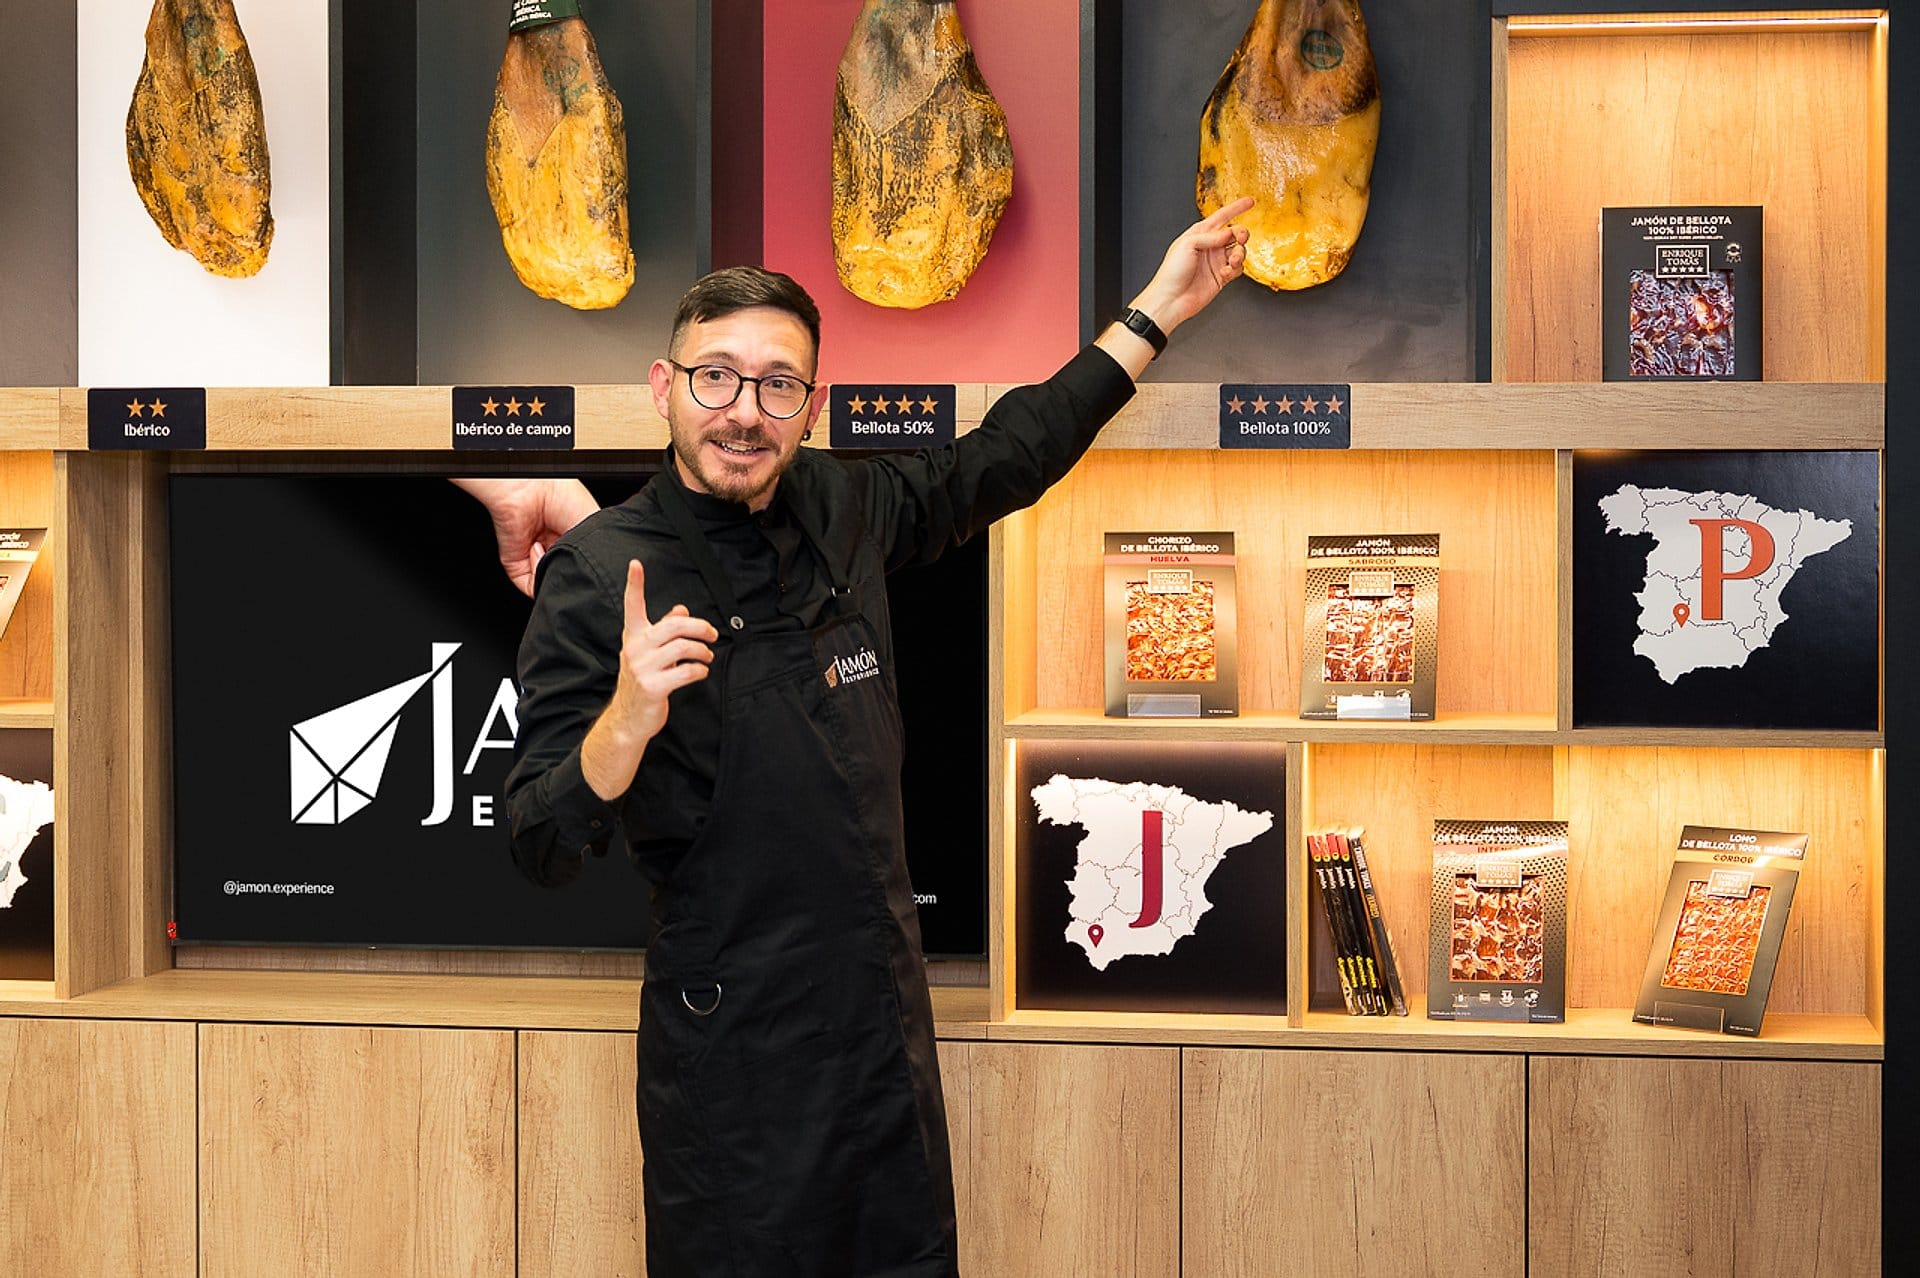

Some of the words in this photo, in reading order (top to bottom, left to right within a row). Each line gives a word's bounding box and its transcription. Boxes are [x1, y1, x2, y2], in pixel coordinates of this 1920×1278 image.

[1631, 214, 1667, 226] JAMÓN
[1669, 216, 1683, 225] DE
[1686, 216, 1732, 225] BELLOTA
[1648, 226, 1674, 235] 100%
[1676, 224, 1718, 235] IBÉRICO
[1661, 249, 1704, 258] ENRIQUE
[124, 423, 171, 436] Ibérico
[455, 423, 503, 435] Ibérico
[506, 423, 523, 435] de
[526, 425, 572, 438] campo
[851, 421, 900, 434] Bellota
[903, 421, 935, 434] 50%
[1239, 421, 1290, 435] Bellota
[1293, 421, 1331, 435] 100%
[1120, 544, 1135, 553] DE
[1355, 538, 1391, 547] JAMÓN
[1310, 548, 1325, 556] DE
[1326, 547, 1369, 556] BELLOTA
[1371, 546, 1396, 555] 100%
[1689, 518, 1776, 620] P
[1729, 834, 1758, 843] LOMO
[1682, 840, 1695, 848] DE
[1696, 840, 1736, 850] BELLOTA
[1128, 810, 1162, 928] J
[223, 880, 335, 896] @jamon.experience
